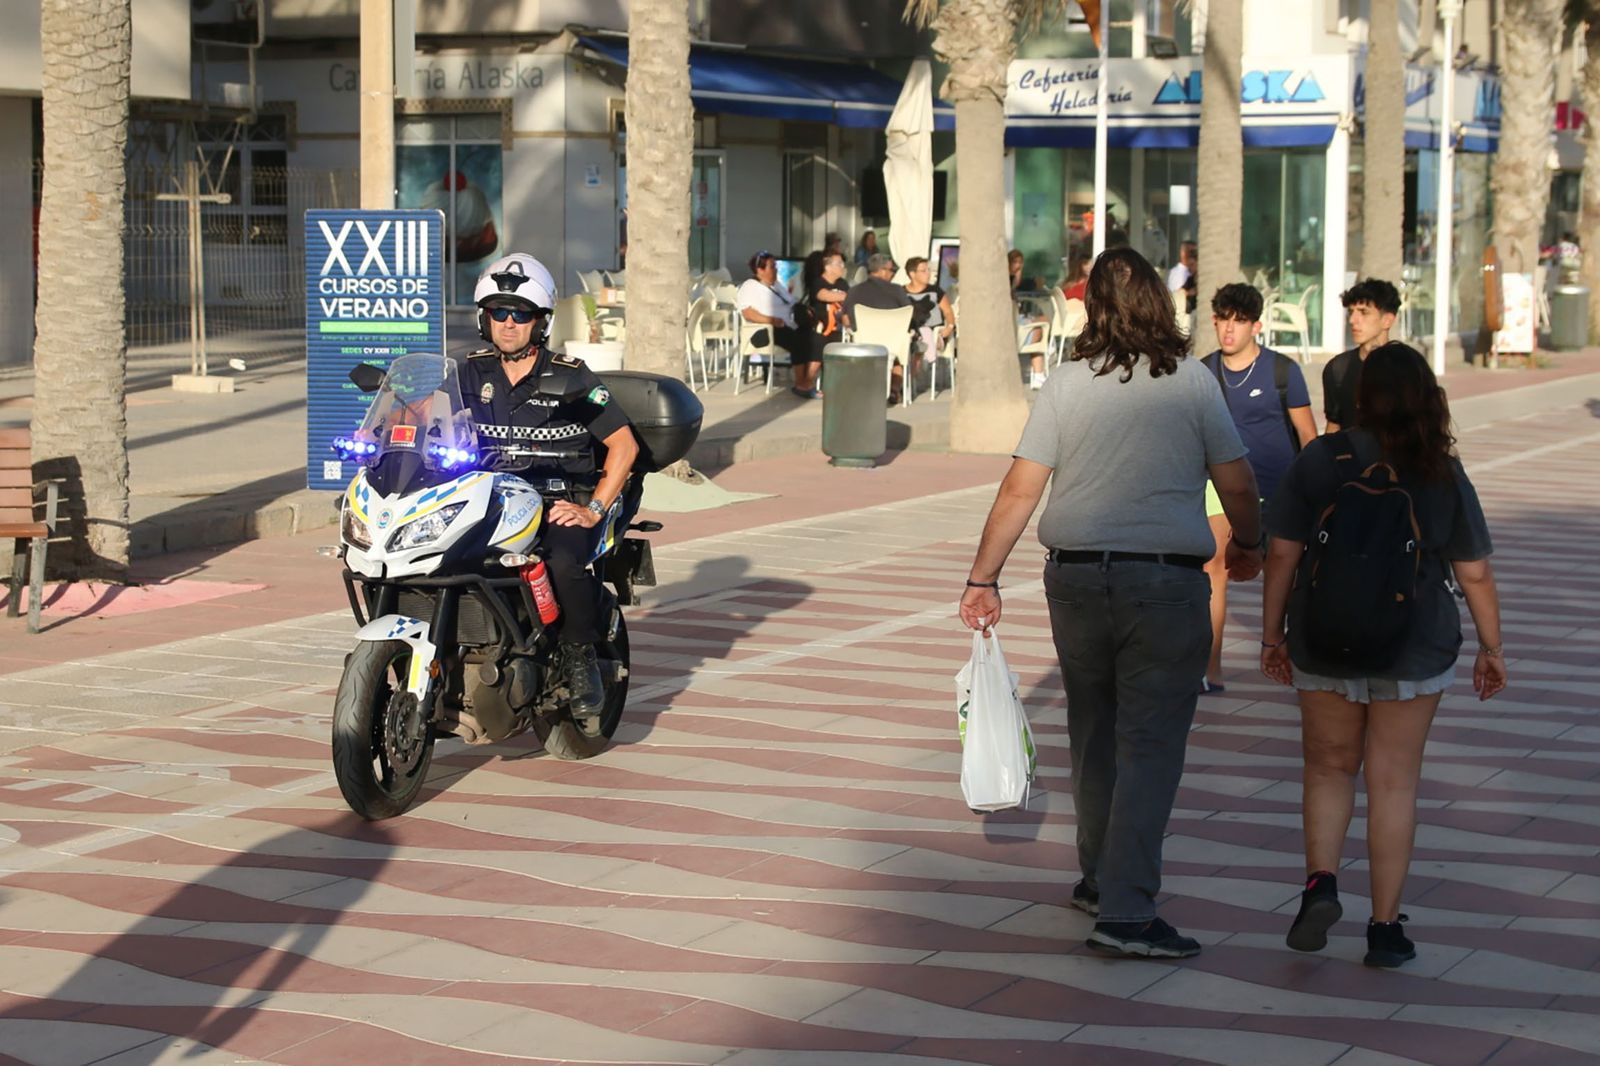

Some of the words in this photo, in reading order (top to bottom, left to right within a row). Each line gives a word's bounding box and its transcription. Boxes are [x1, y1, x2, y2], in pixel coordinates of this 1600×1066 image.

[317, 220, 428, 276] XXIII
[319, 278, 398, 295] CURSOS
[402, 278, 429, 295] DE
[320, 298, 429, 318] VERANO
